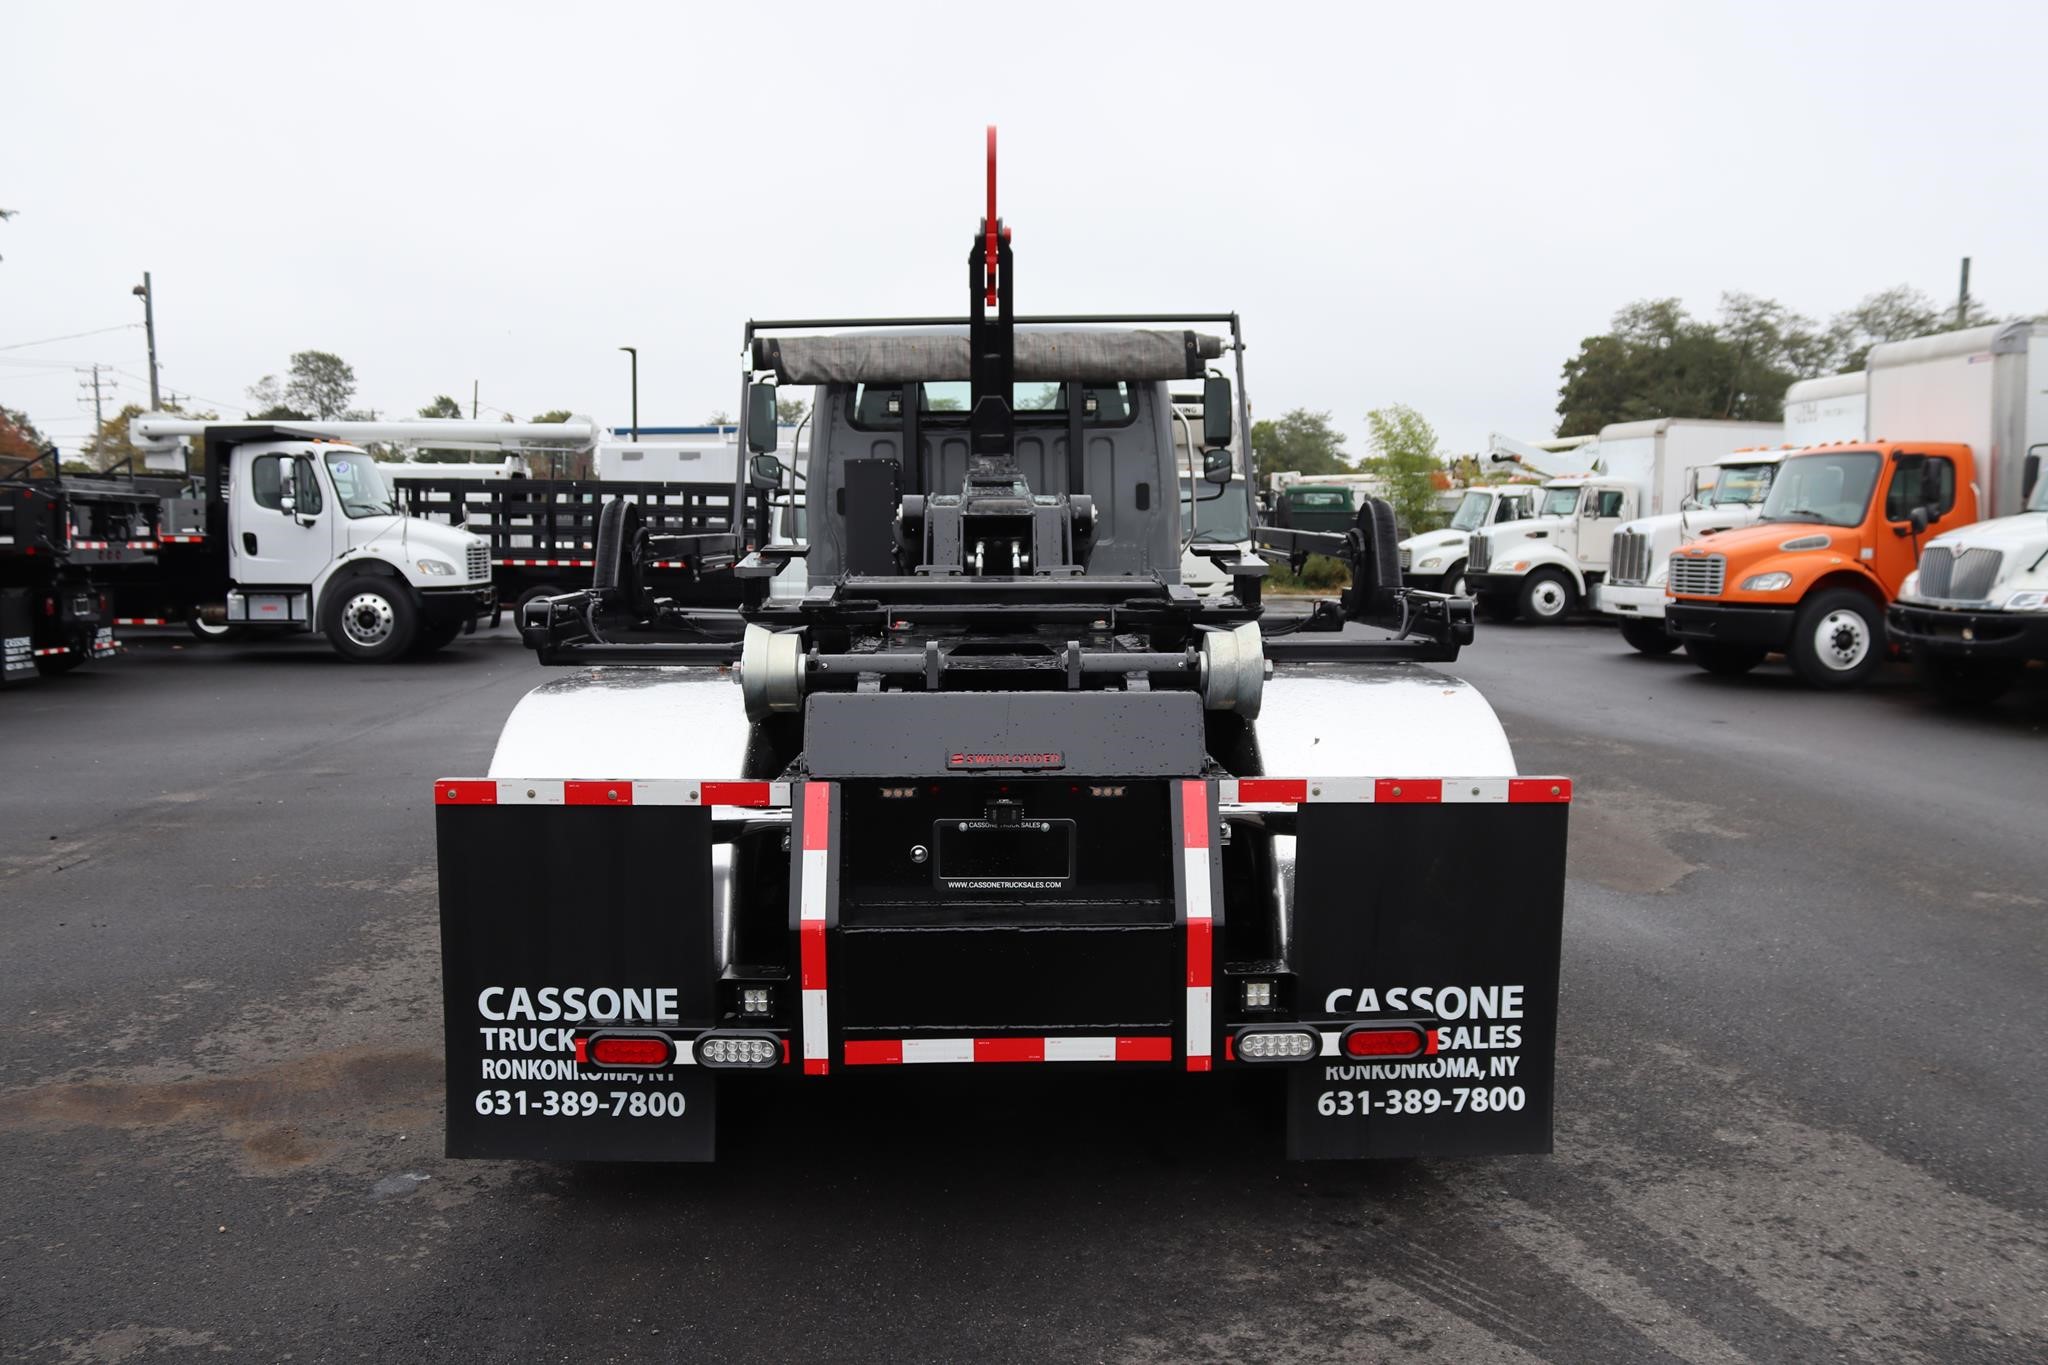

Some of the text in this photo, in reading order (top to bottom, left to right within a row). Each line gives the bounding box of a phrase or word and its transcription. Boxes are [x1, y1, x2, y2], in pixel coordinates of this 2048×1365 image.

[948, 881, 1062, 889] WWW.CASSONETRUCKSALES.COM
[478, 986, 679, 1021] CASSONE
[1325, 985, 1524, 1020] CASSONE
[480, 1027, 577, 1051] TRUCK
[1437, 1025, 1522, 1050] SALES
[1490, 1056, 1520, 1077] NY
[475, 1090, 686, 1117] 631-389-7800
[1317, 1086, 1526, 1116] 631-389-7800
